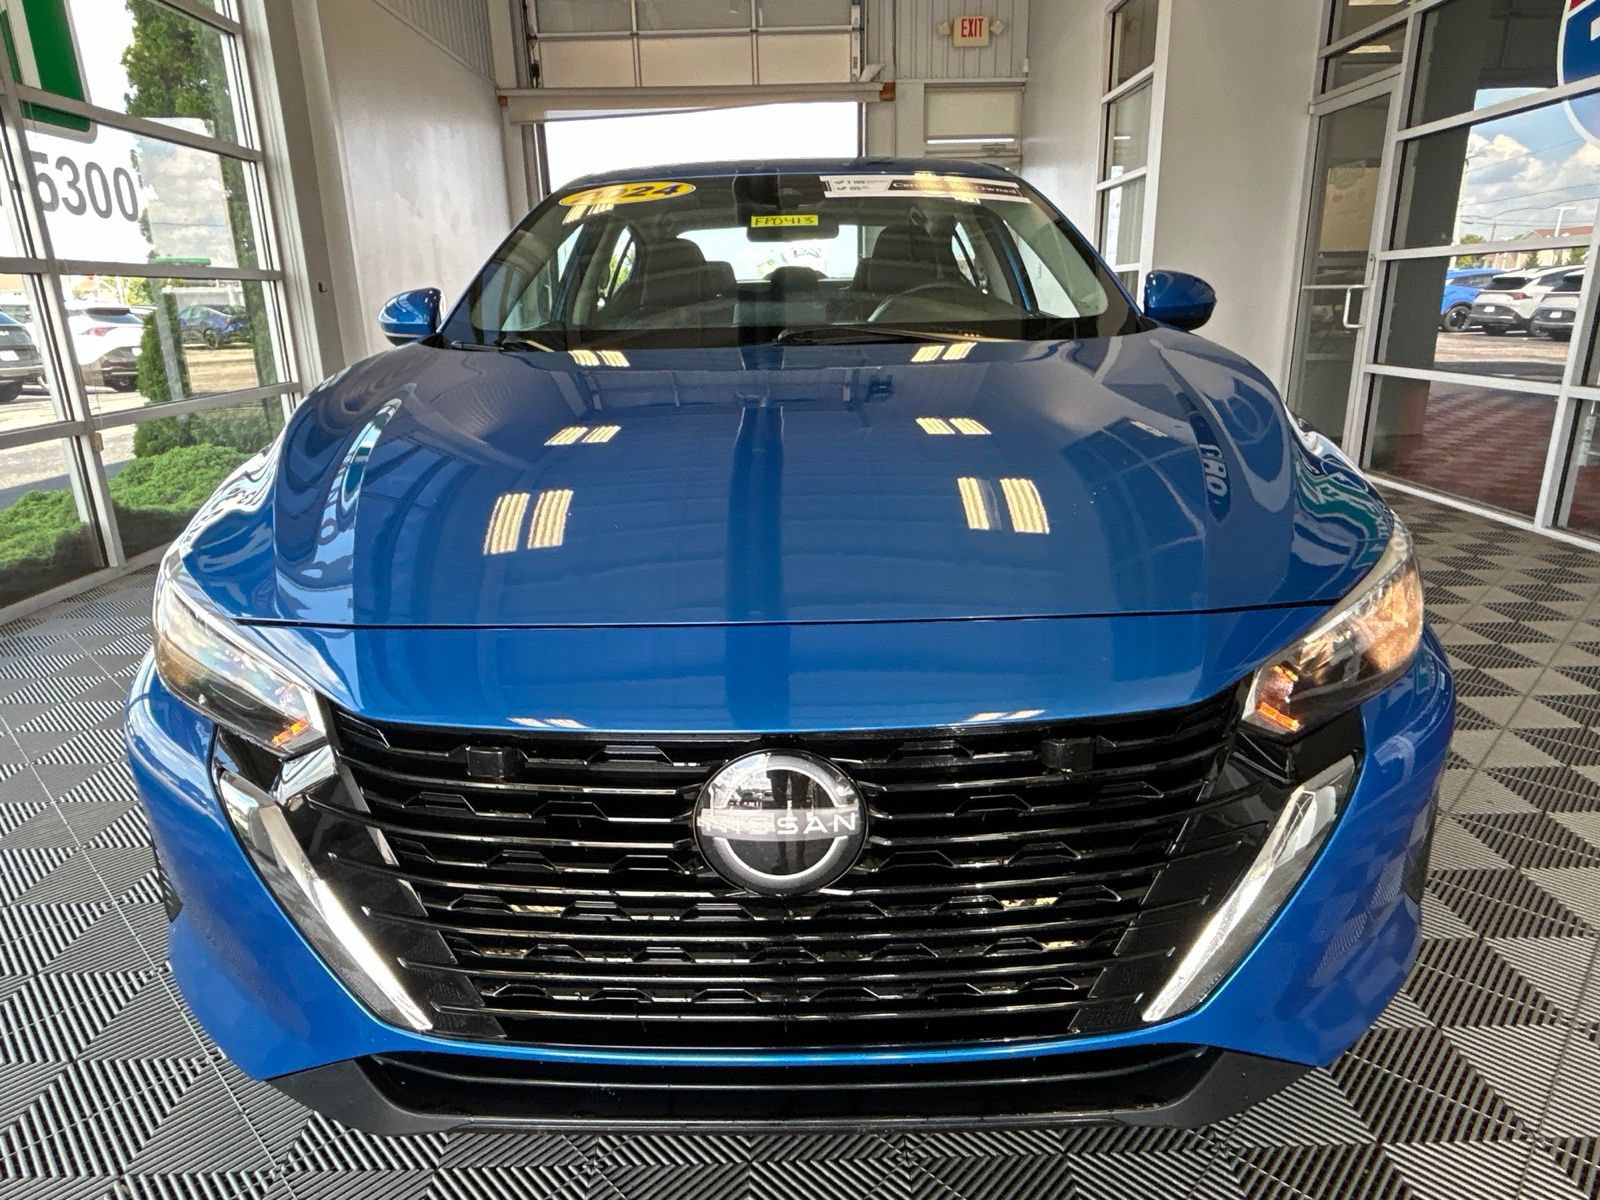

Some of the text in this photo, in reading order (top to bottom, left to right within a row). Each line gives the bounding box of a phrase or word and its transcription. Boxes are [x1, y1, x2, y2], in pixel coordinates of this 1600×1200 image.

[961, 18, 984, 37] EXIT
[30, 150, 139, 222] 5300
[701, 812, 856, 835] NISSAN
